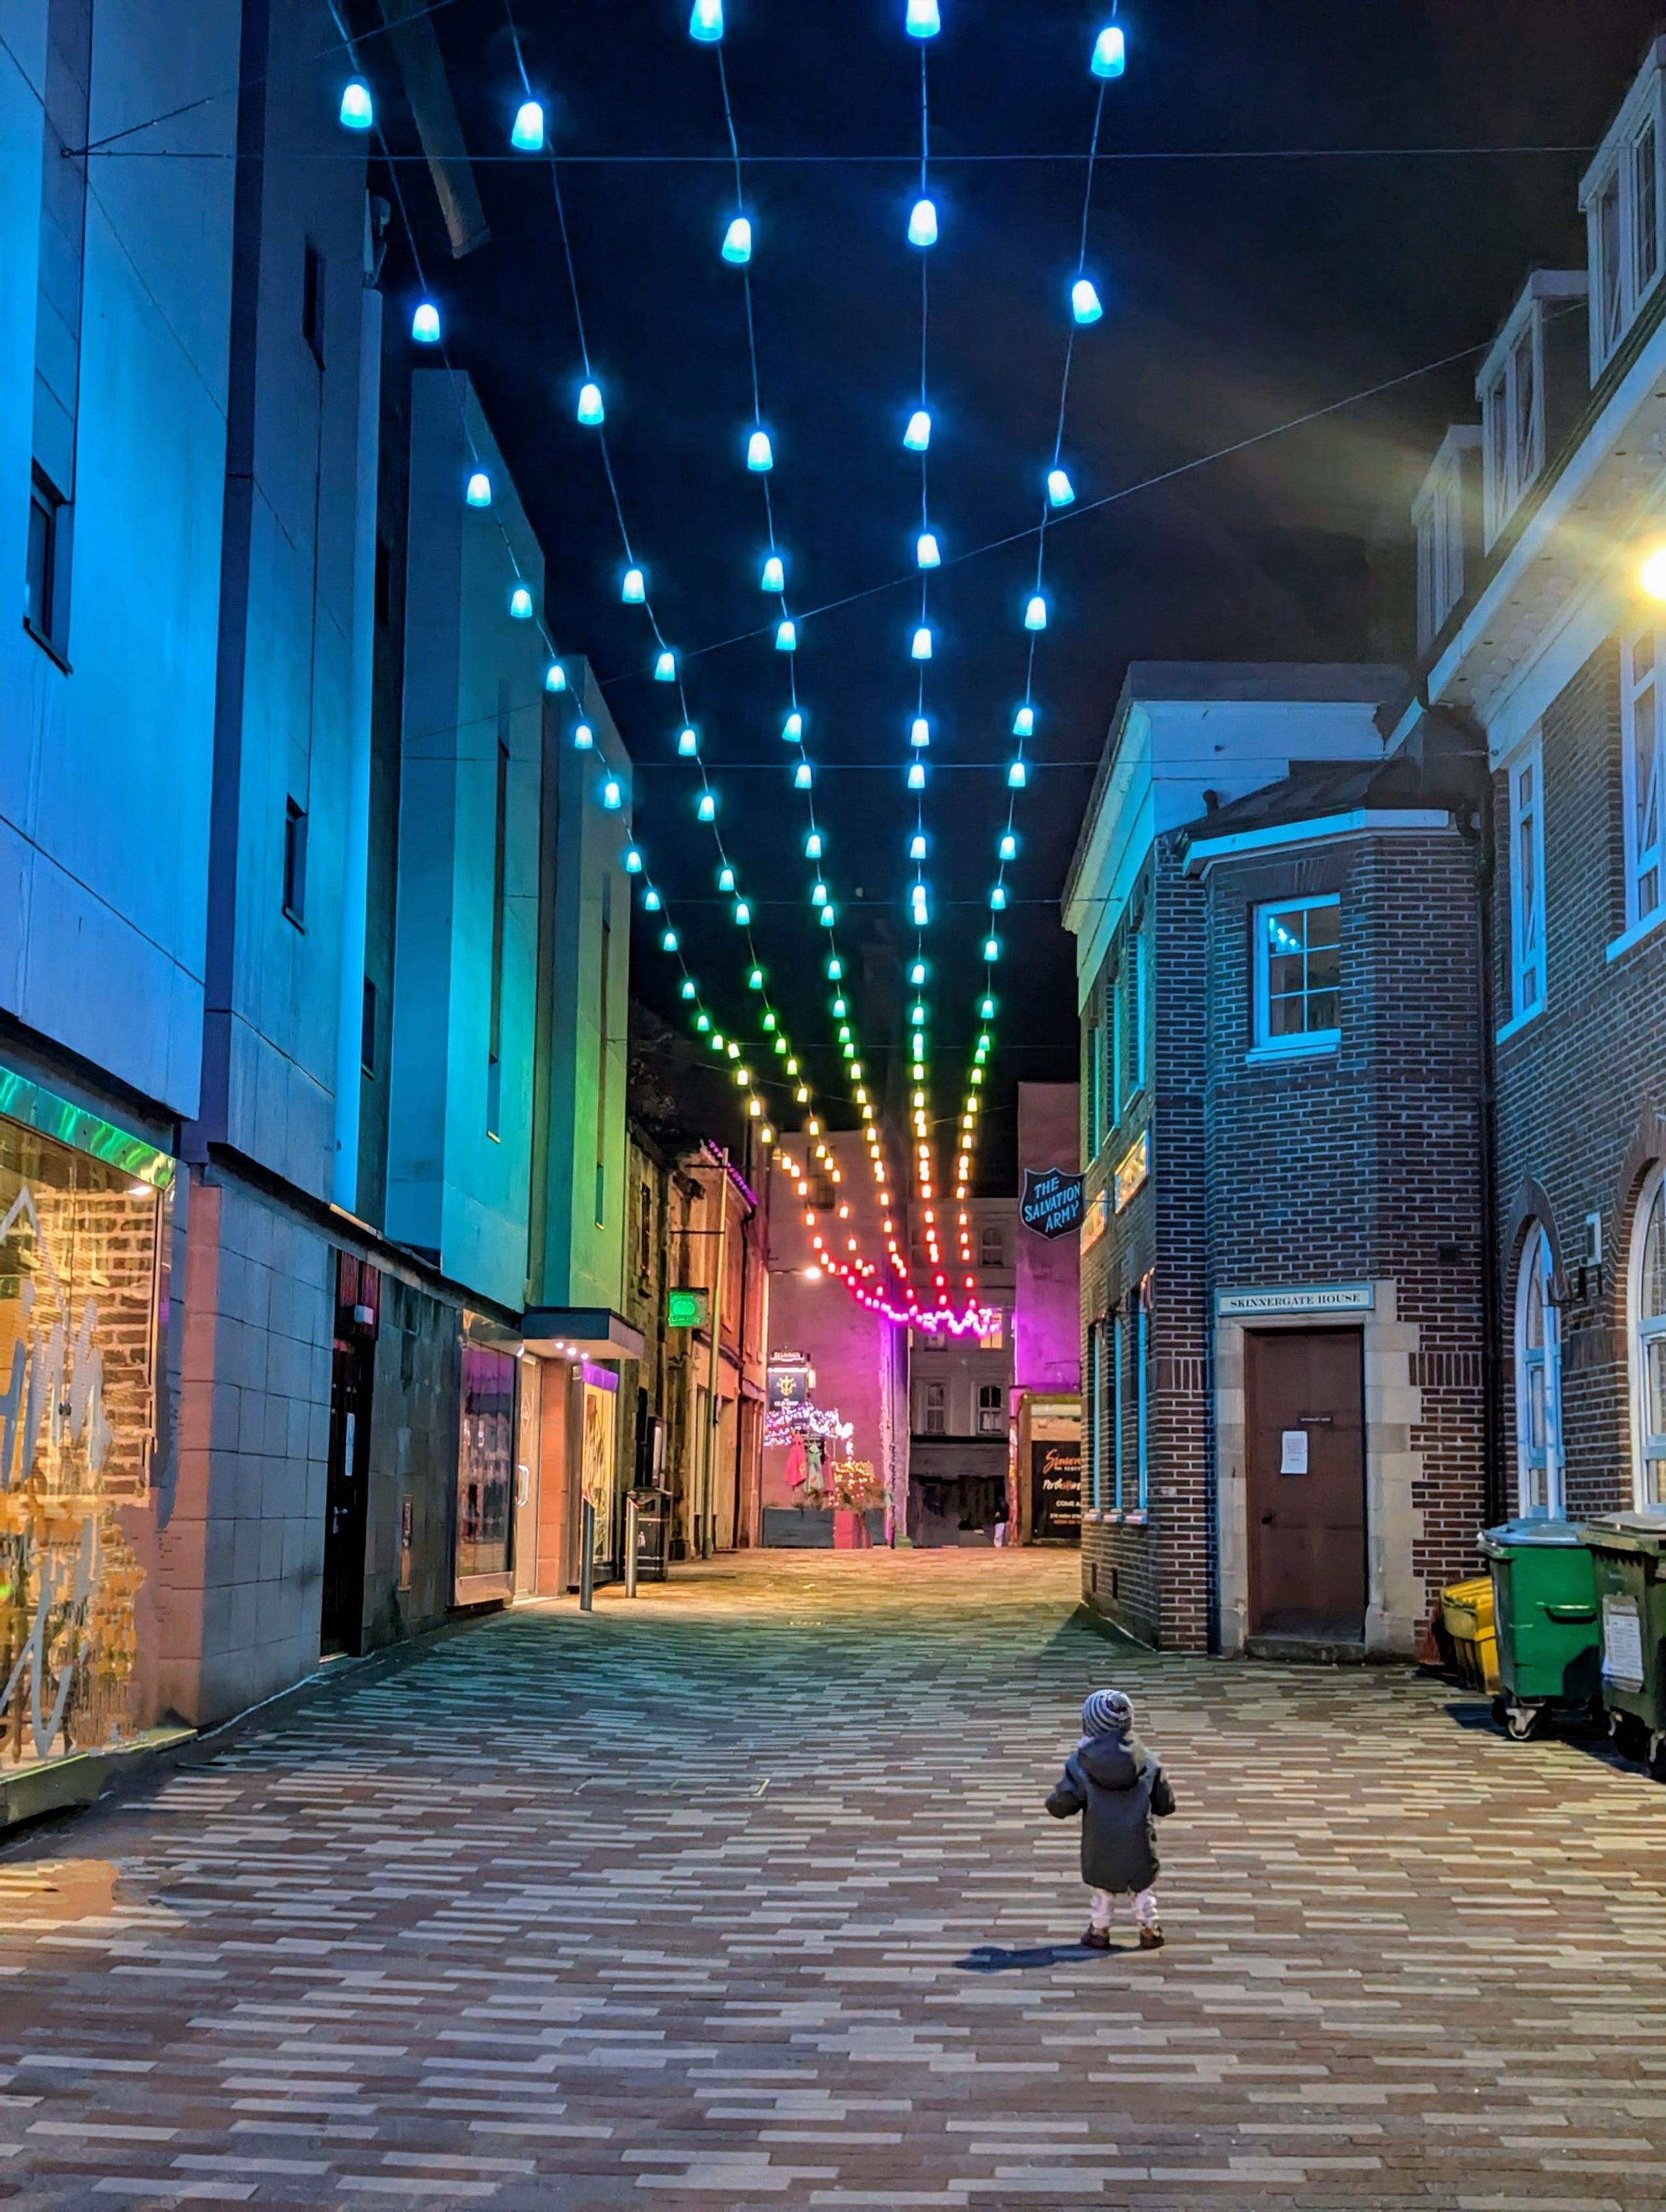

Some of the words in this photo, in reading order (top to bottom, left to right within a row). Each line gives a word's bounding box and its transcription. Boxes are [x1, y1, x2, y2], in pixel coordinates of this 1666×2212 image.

[1034, 1176, 1059, 1198] THE
[1024, 1181, 1080, 1222] SALVATION
[1045, 1200, 1079, 1233] ARMY
[1231, 1295, 1315, 1308] SKINNERGATE
[1318, 1293, 1360, 1304] HOUSE
